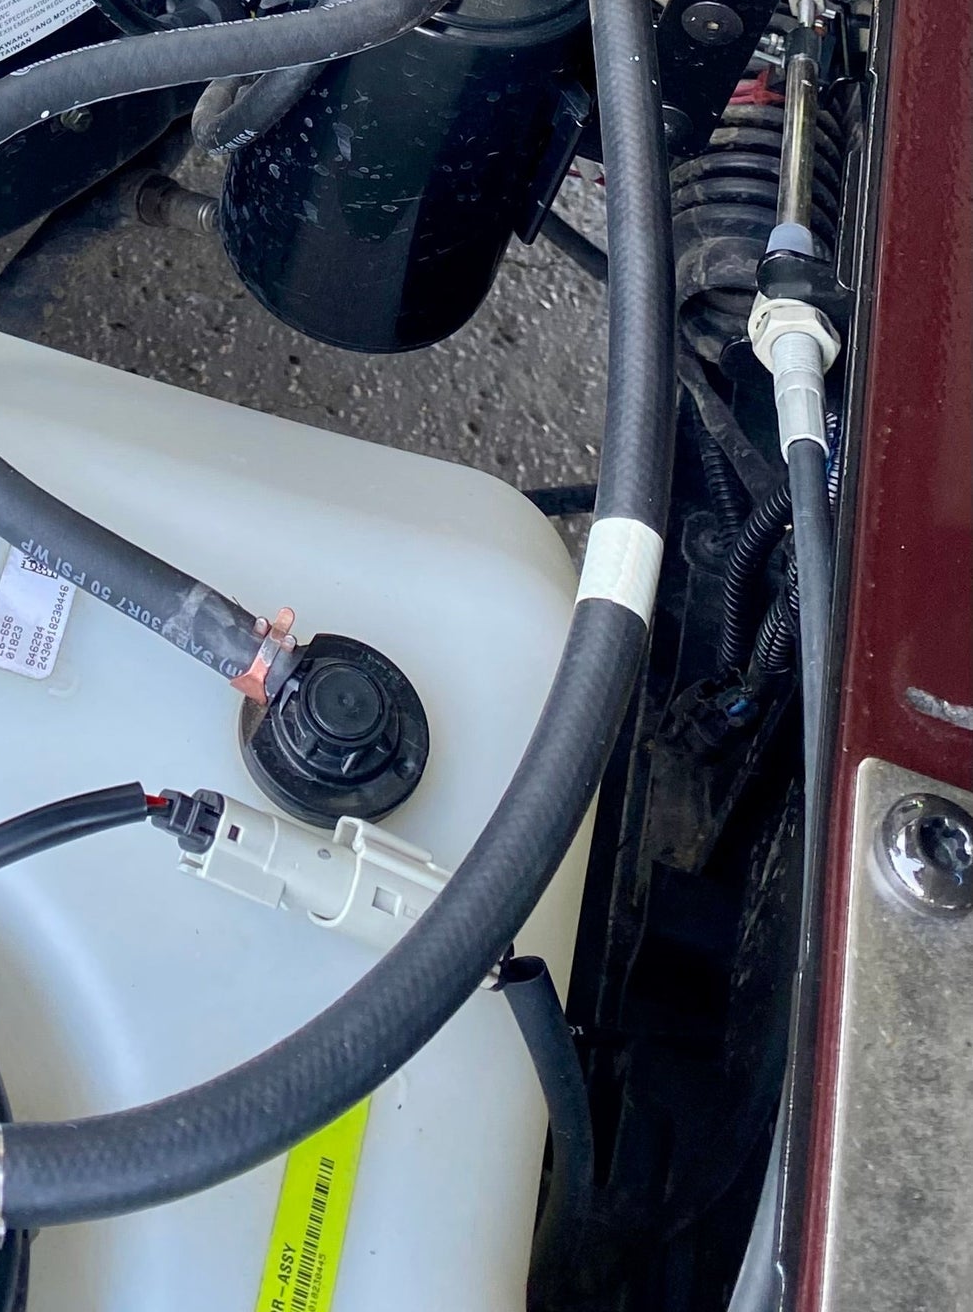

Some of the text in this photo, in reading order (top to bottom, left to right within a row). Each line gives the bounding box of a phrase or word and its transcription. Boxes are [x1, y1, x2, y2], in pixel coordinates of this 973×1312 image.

[12, 6, 46, 29] EMISSION
[29, 17, 52, 33] YANG
[52, 0, 81, 21] MOTOR
[0, 37, 32, 57] TAIWAN
[232, 125, 259, 145] USA
[20, 538, 50, 562] WP
[52, 554, 85, 586] PSI
[90, 578, 111, 601] 50
[5, 625, 24, 660] 01823
[25, 625, 45, 667] 646284
[270, 1242, 297, 1312] R-ASSY
